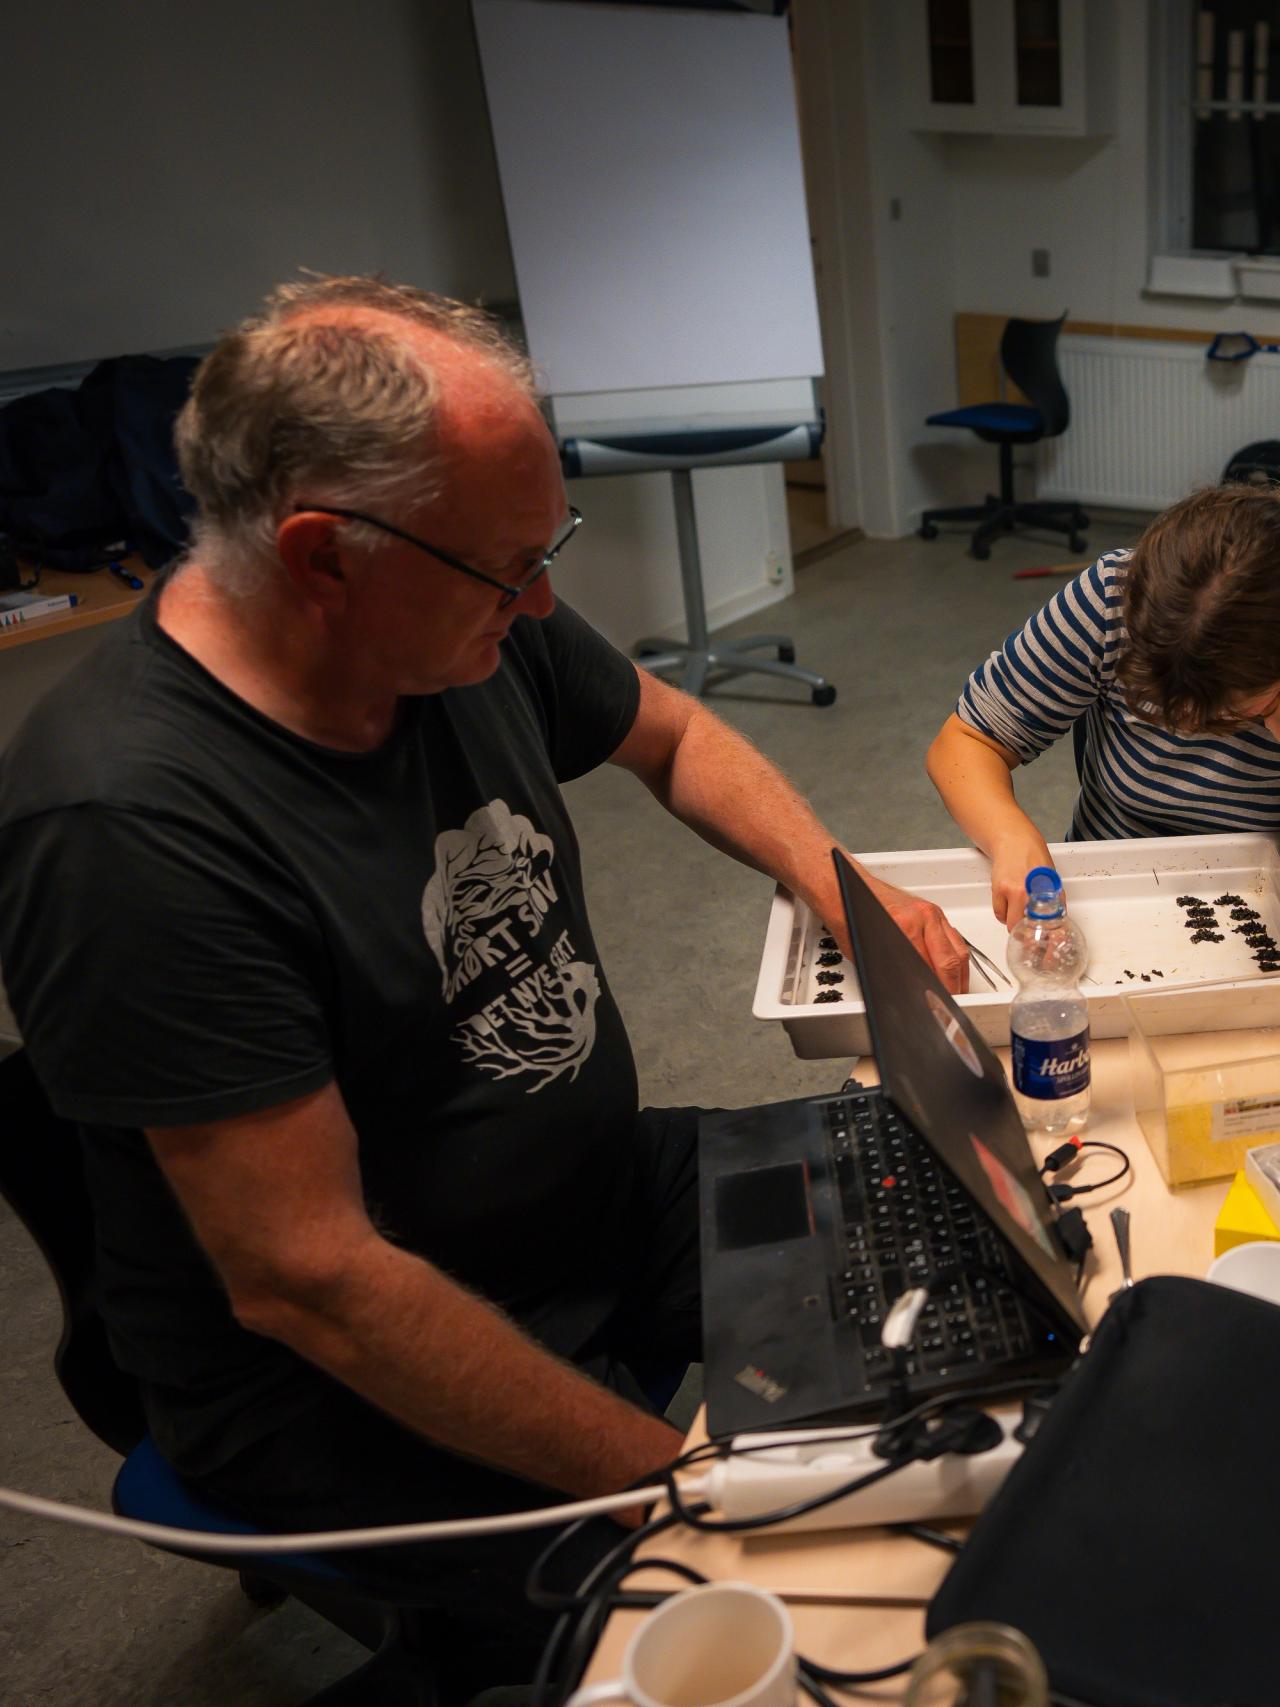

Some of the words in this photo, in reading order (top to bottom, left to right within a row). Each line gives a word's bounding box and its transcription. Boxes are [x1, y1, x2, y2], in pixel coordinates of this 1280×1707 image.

[467, 993, 508, 1037] DET
[510, 963, 555, 1009] NYE
[1040, 1048, 1090, 1077] Harb
